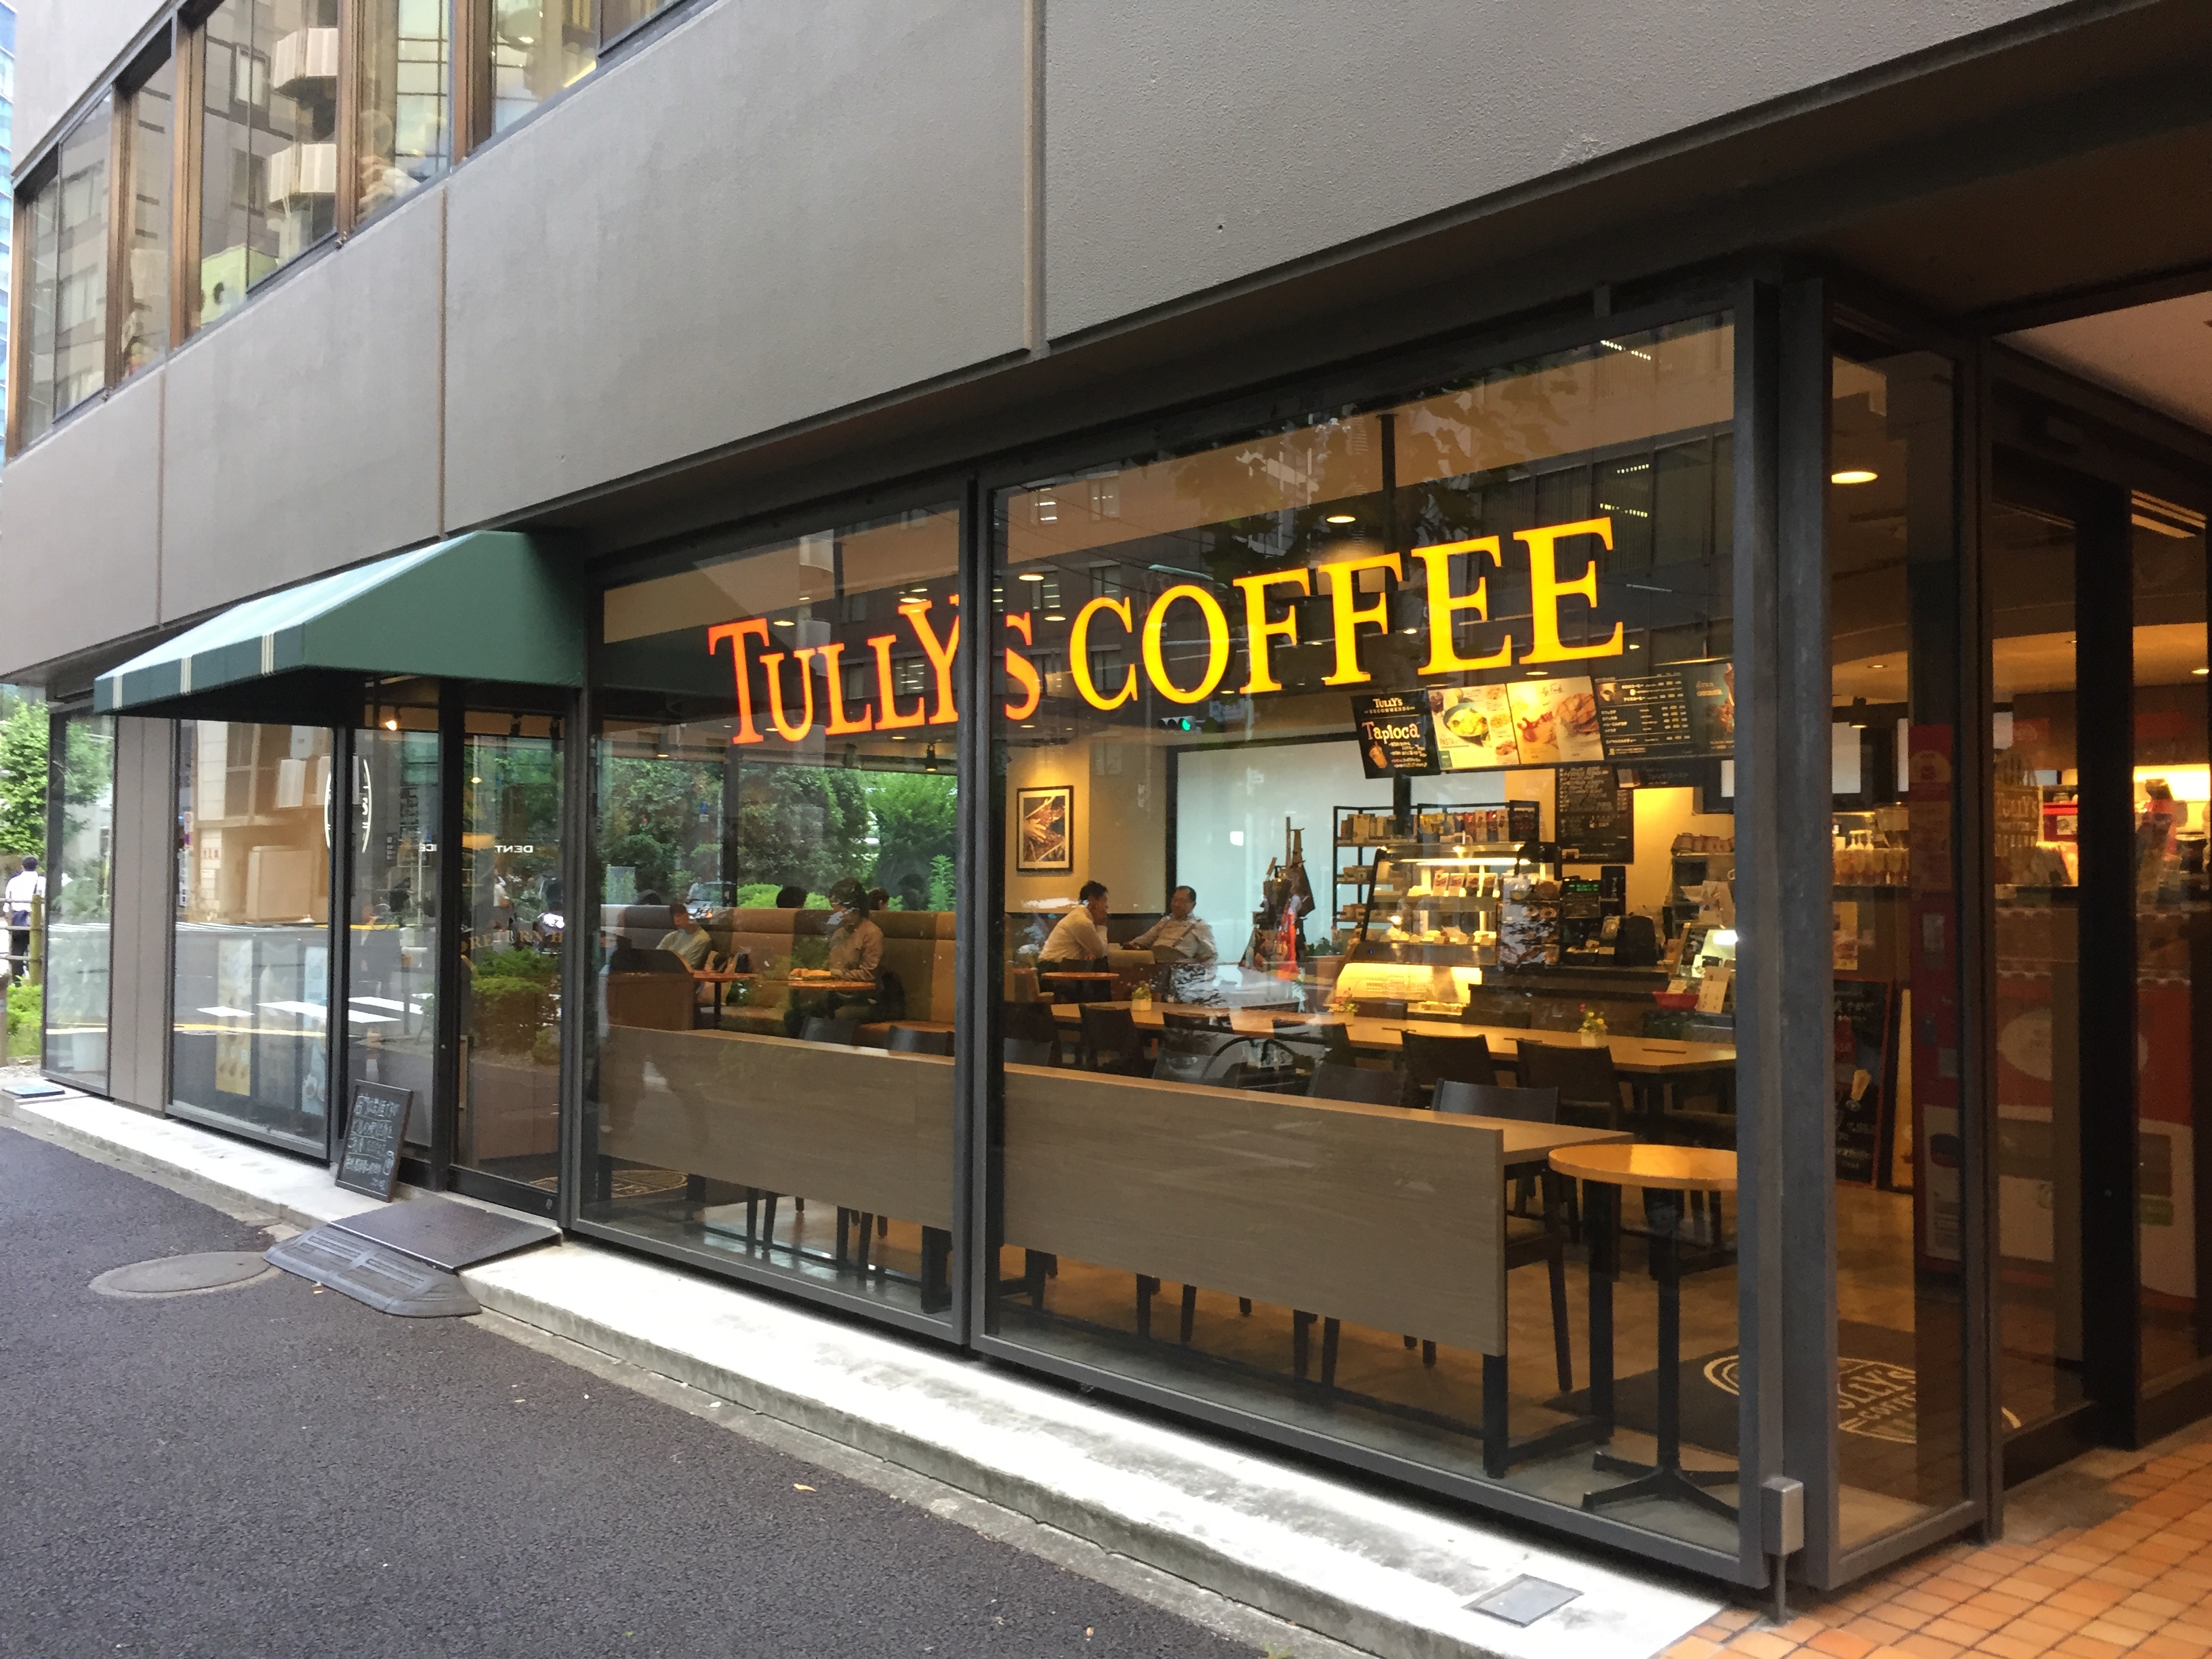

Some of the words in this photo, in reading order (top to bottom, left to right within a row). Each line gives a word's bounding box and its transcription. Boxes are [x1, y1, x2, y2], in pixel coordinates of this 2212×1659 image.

[708, 594, 1041, 745] TULLYS
[1069, 517, 1624, 711] COFFEE
[1361, 720, 1420, 744] Tapioca
